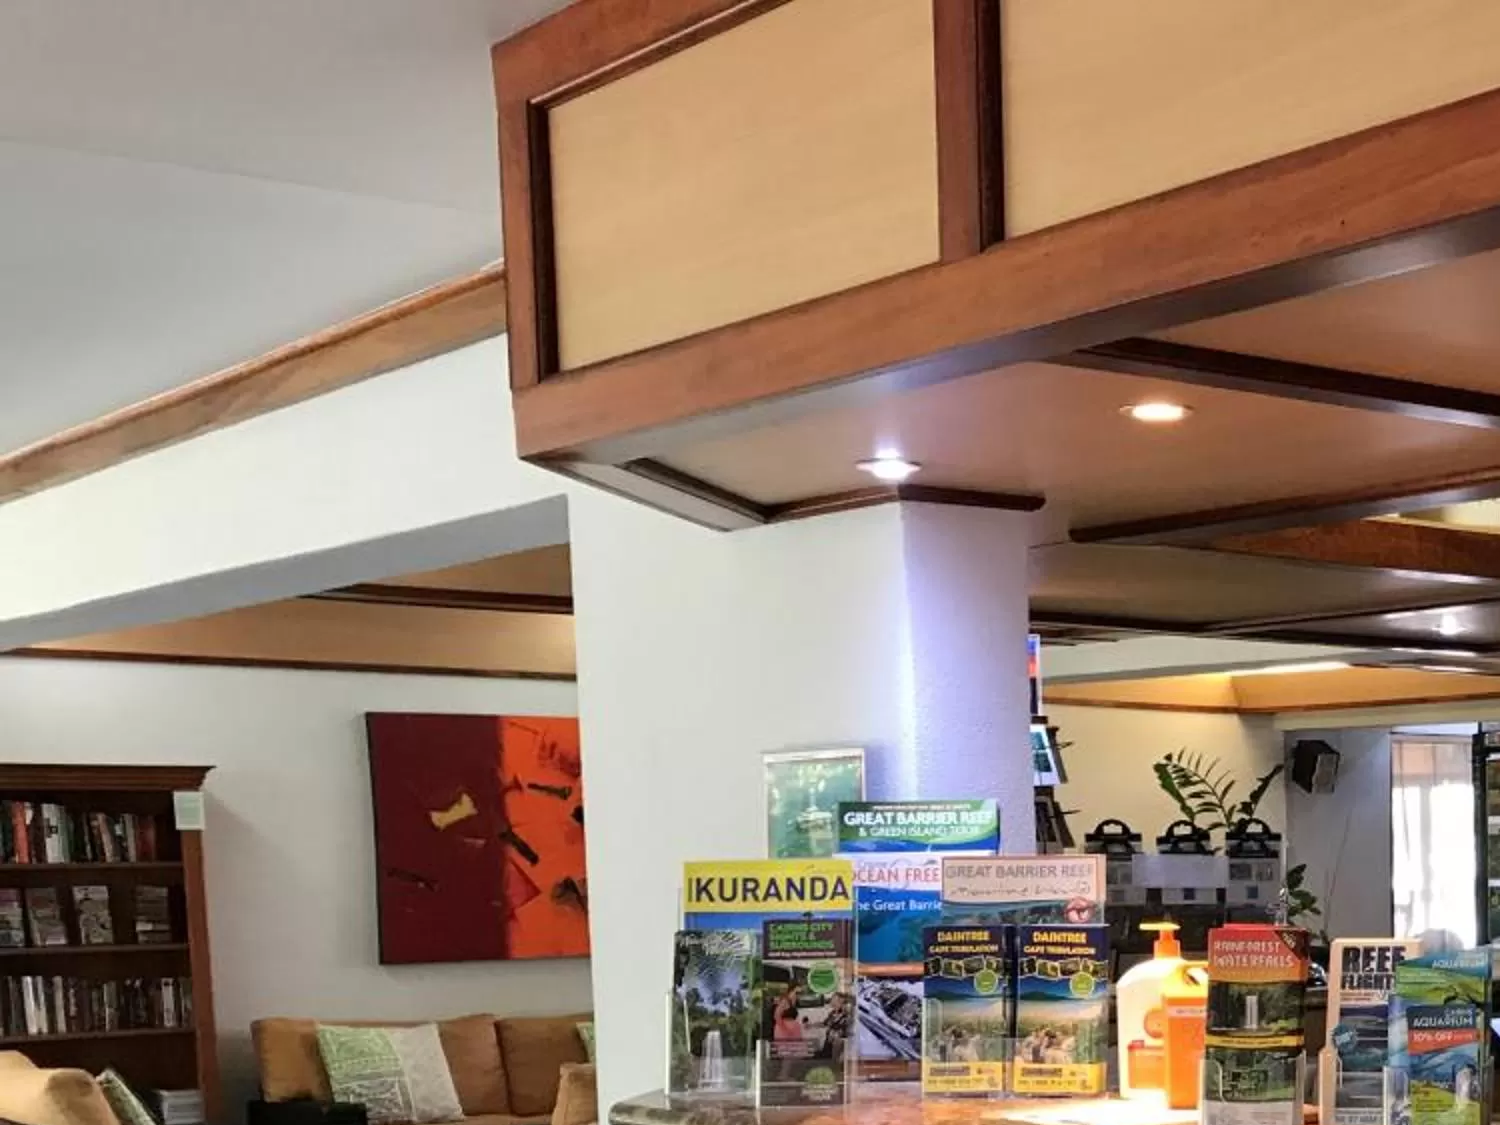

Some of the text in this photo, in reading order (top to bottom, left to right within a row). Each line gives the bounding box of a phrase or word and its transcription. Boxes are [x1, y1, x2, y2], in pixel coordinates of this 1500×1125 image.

[843, 811, 896, 826] GREAT
[899, 811, 958, 826] BARRIER
[905, 867, 940, 883] FREE
[945, 865, 992, 880] GREAT
[996, 865, 1057, 879] BARRIER
[695, 876, 850, 903] KURANDA
[872, 899, 906, 912] Great
[909, 899, 942, 912] Barrie
[937, 930, 991, 943] DAINTREE
[1032, 931, 1087, 944] DAINTREE
[1213, 940, 1281, 954] RAINFOREST
[1213, 954, 1295, 968] WATERFALLS
[1342, 946, 1407, 973] REEF
[1342, 973, 1396, 990] FLIGHT
[1413, 1014, 1474, 1028] AQUARIUM
